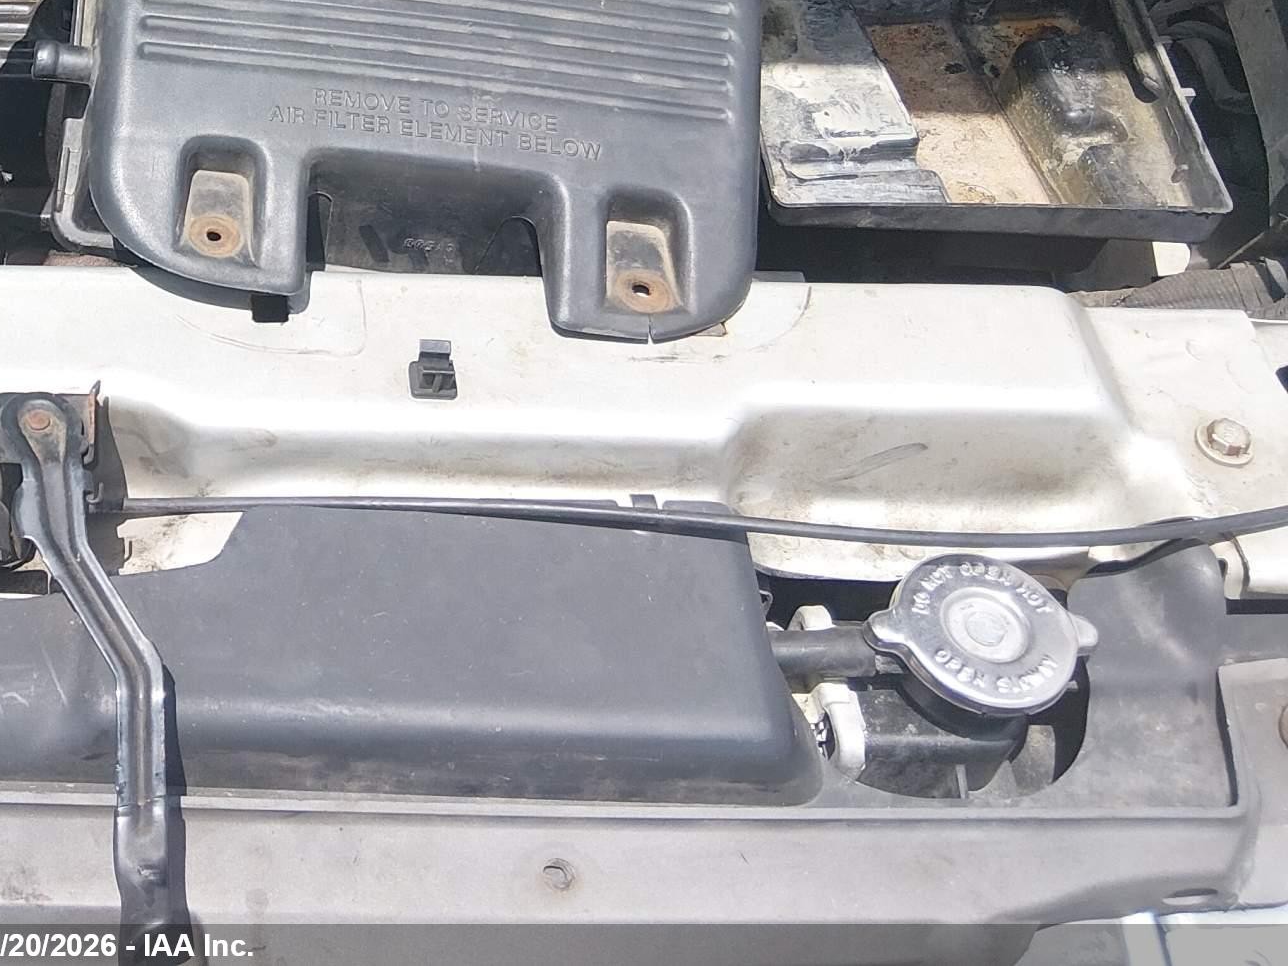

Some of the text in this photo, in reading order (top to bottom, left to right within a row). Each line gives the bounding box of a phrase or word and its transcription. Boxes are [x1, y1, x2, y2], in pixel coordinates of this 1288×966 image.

[271, 105, 602, 162] AIR FILTER ELEMENT BELOW
[313, 88, 559, 134] REMOVE TO SERVICE
[911, 561, 1054, 615] DO NOT OPEN HOT
[934, 648, 987, 689] OPEN
